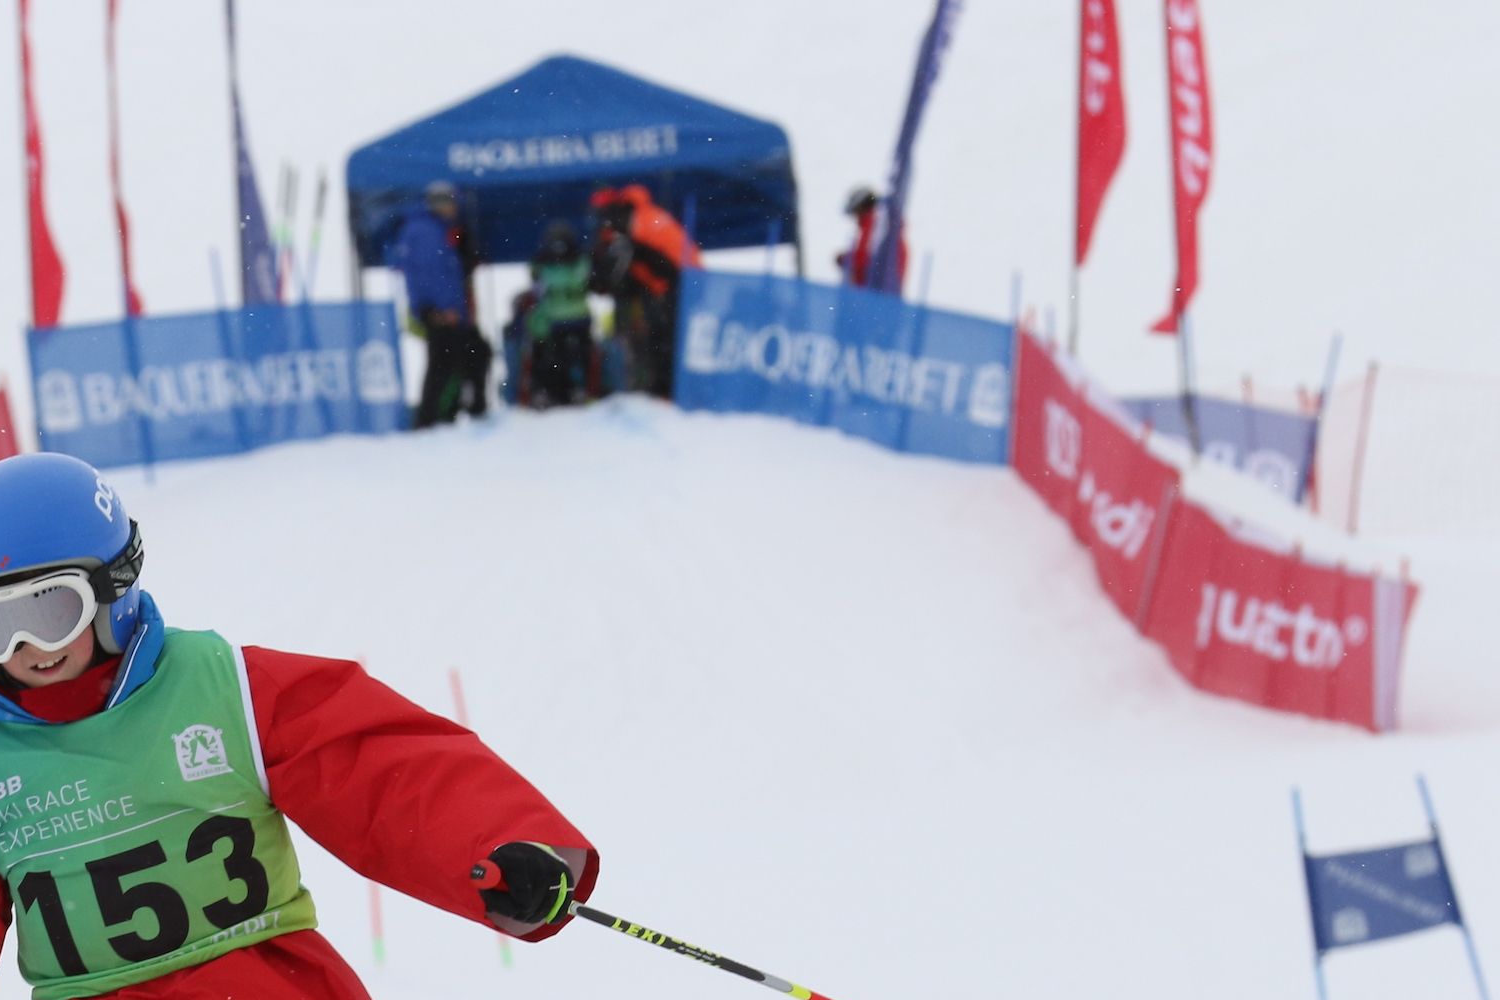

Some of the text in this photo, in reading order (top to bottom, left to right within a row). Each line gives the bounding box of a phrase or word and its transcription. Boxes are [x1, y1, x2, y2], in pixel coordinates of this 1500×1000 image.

[26, 779, 91, 815] RACE
[17, 815, 269, 977] 153
[611, 917, 667, 946] LEKI
